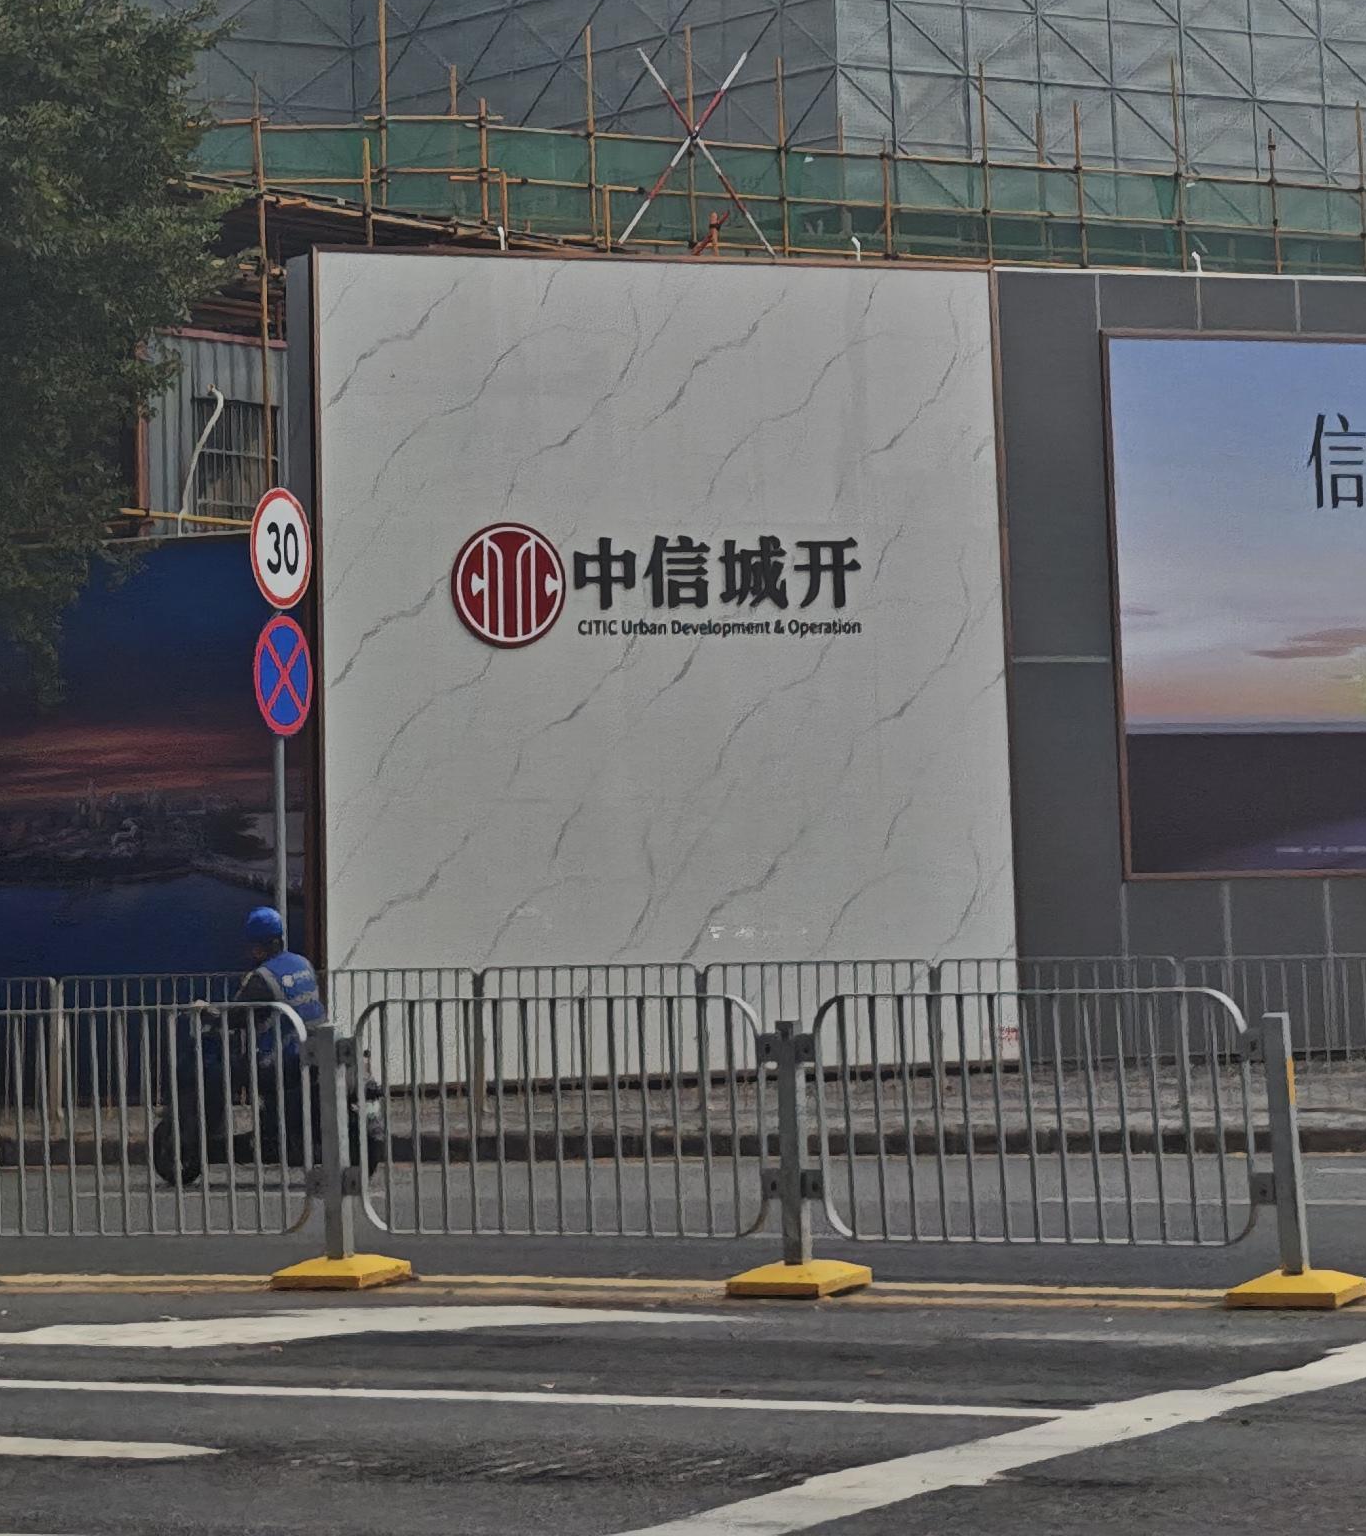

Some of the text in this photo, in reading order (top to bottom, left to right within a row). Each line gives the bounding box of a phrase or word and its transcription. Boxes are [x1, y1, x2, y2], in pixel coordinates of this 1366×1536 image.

[266, 521, 300, 576] 30
[573, 534, 862, 610] 中信城开
[577, 618, 862, 638] CITIC Urban Development & Operation
